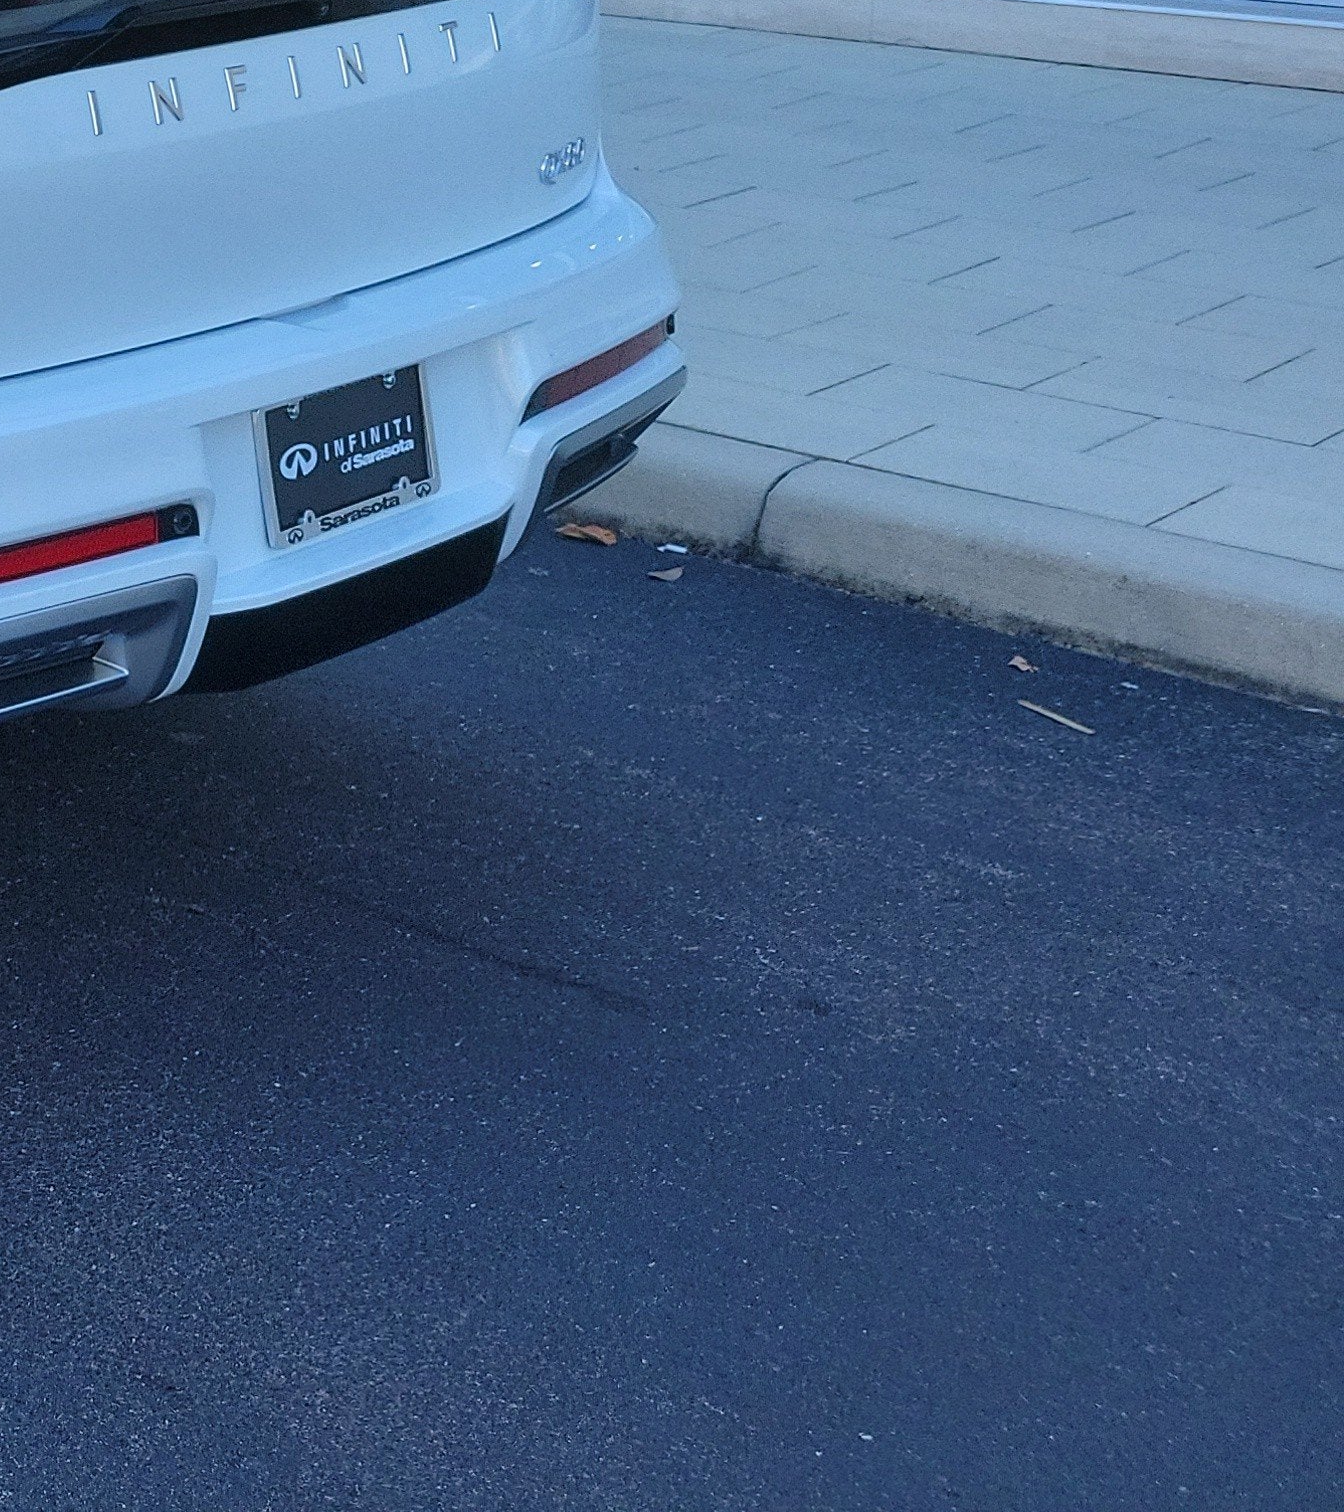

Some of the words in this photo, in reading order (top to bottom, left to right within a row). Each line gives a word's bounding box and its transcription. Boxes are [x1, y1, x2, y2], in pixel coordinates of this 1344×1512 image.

[86, 11, 502, 136] INFINITI
[323, 414, 413, 462] INFINITI
[352, 438, 415, 470] Sarasota
[319, 494, 401, 532] Sarasota
